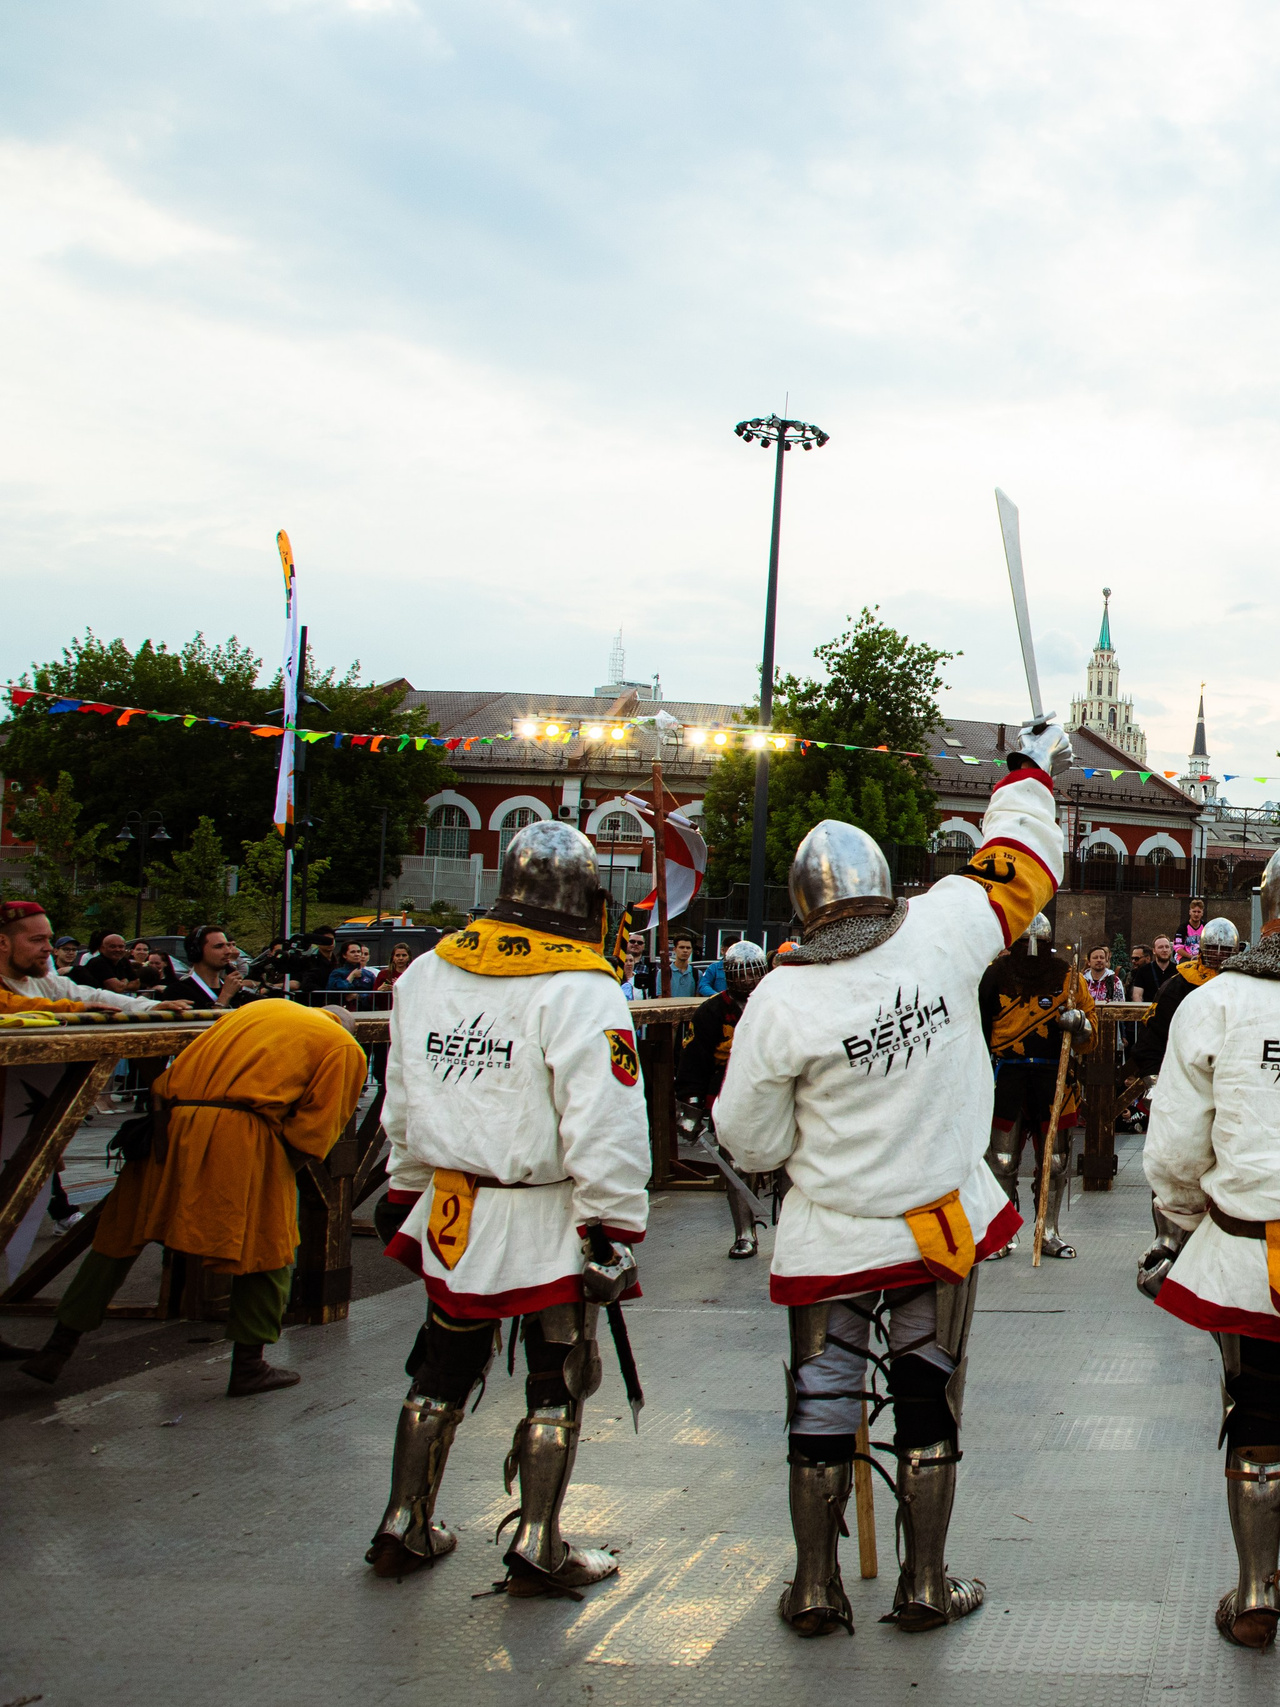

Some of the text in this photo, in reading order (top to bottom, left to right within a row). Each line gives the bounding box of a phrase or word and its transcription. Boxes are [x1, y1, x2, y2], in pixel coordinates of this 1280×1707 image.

[875, 1004, 912, 1023] КЛУБ
[453, 1028, 483, 1036] КЛУБ
[849, 1017, 950, 1068] ЕДИНОБОРСТВ
[426, 1053, 511, 1069] ЕДИНОБОРСТВ
[438, 1194, 460, 1246] 2
[929, 1206, 959, 1256] 1
